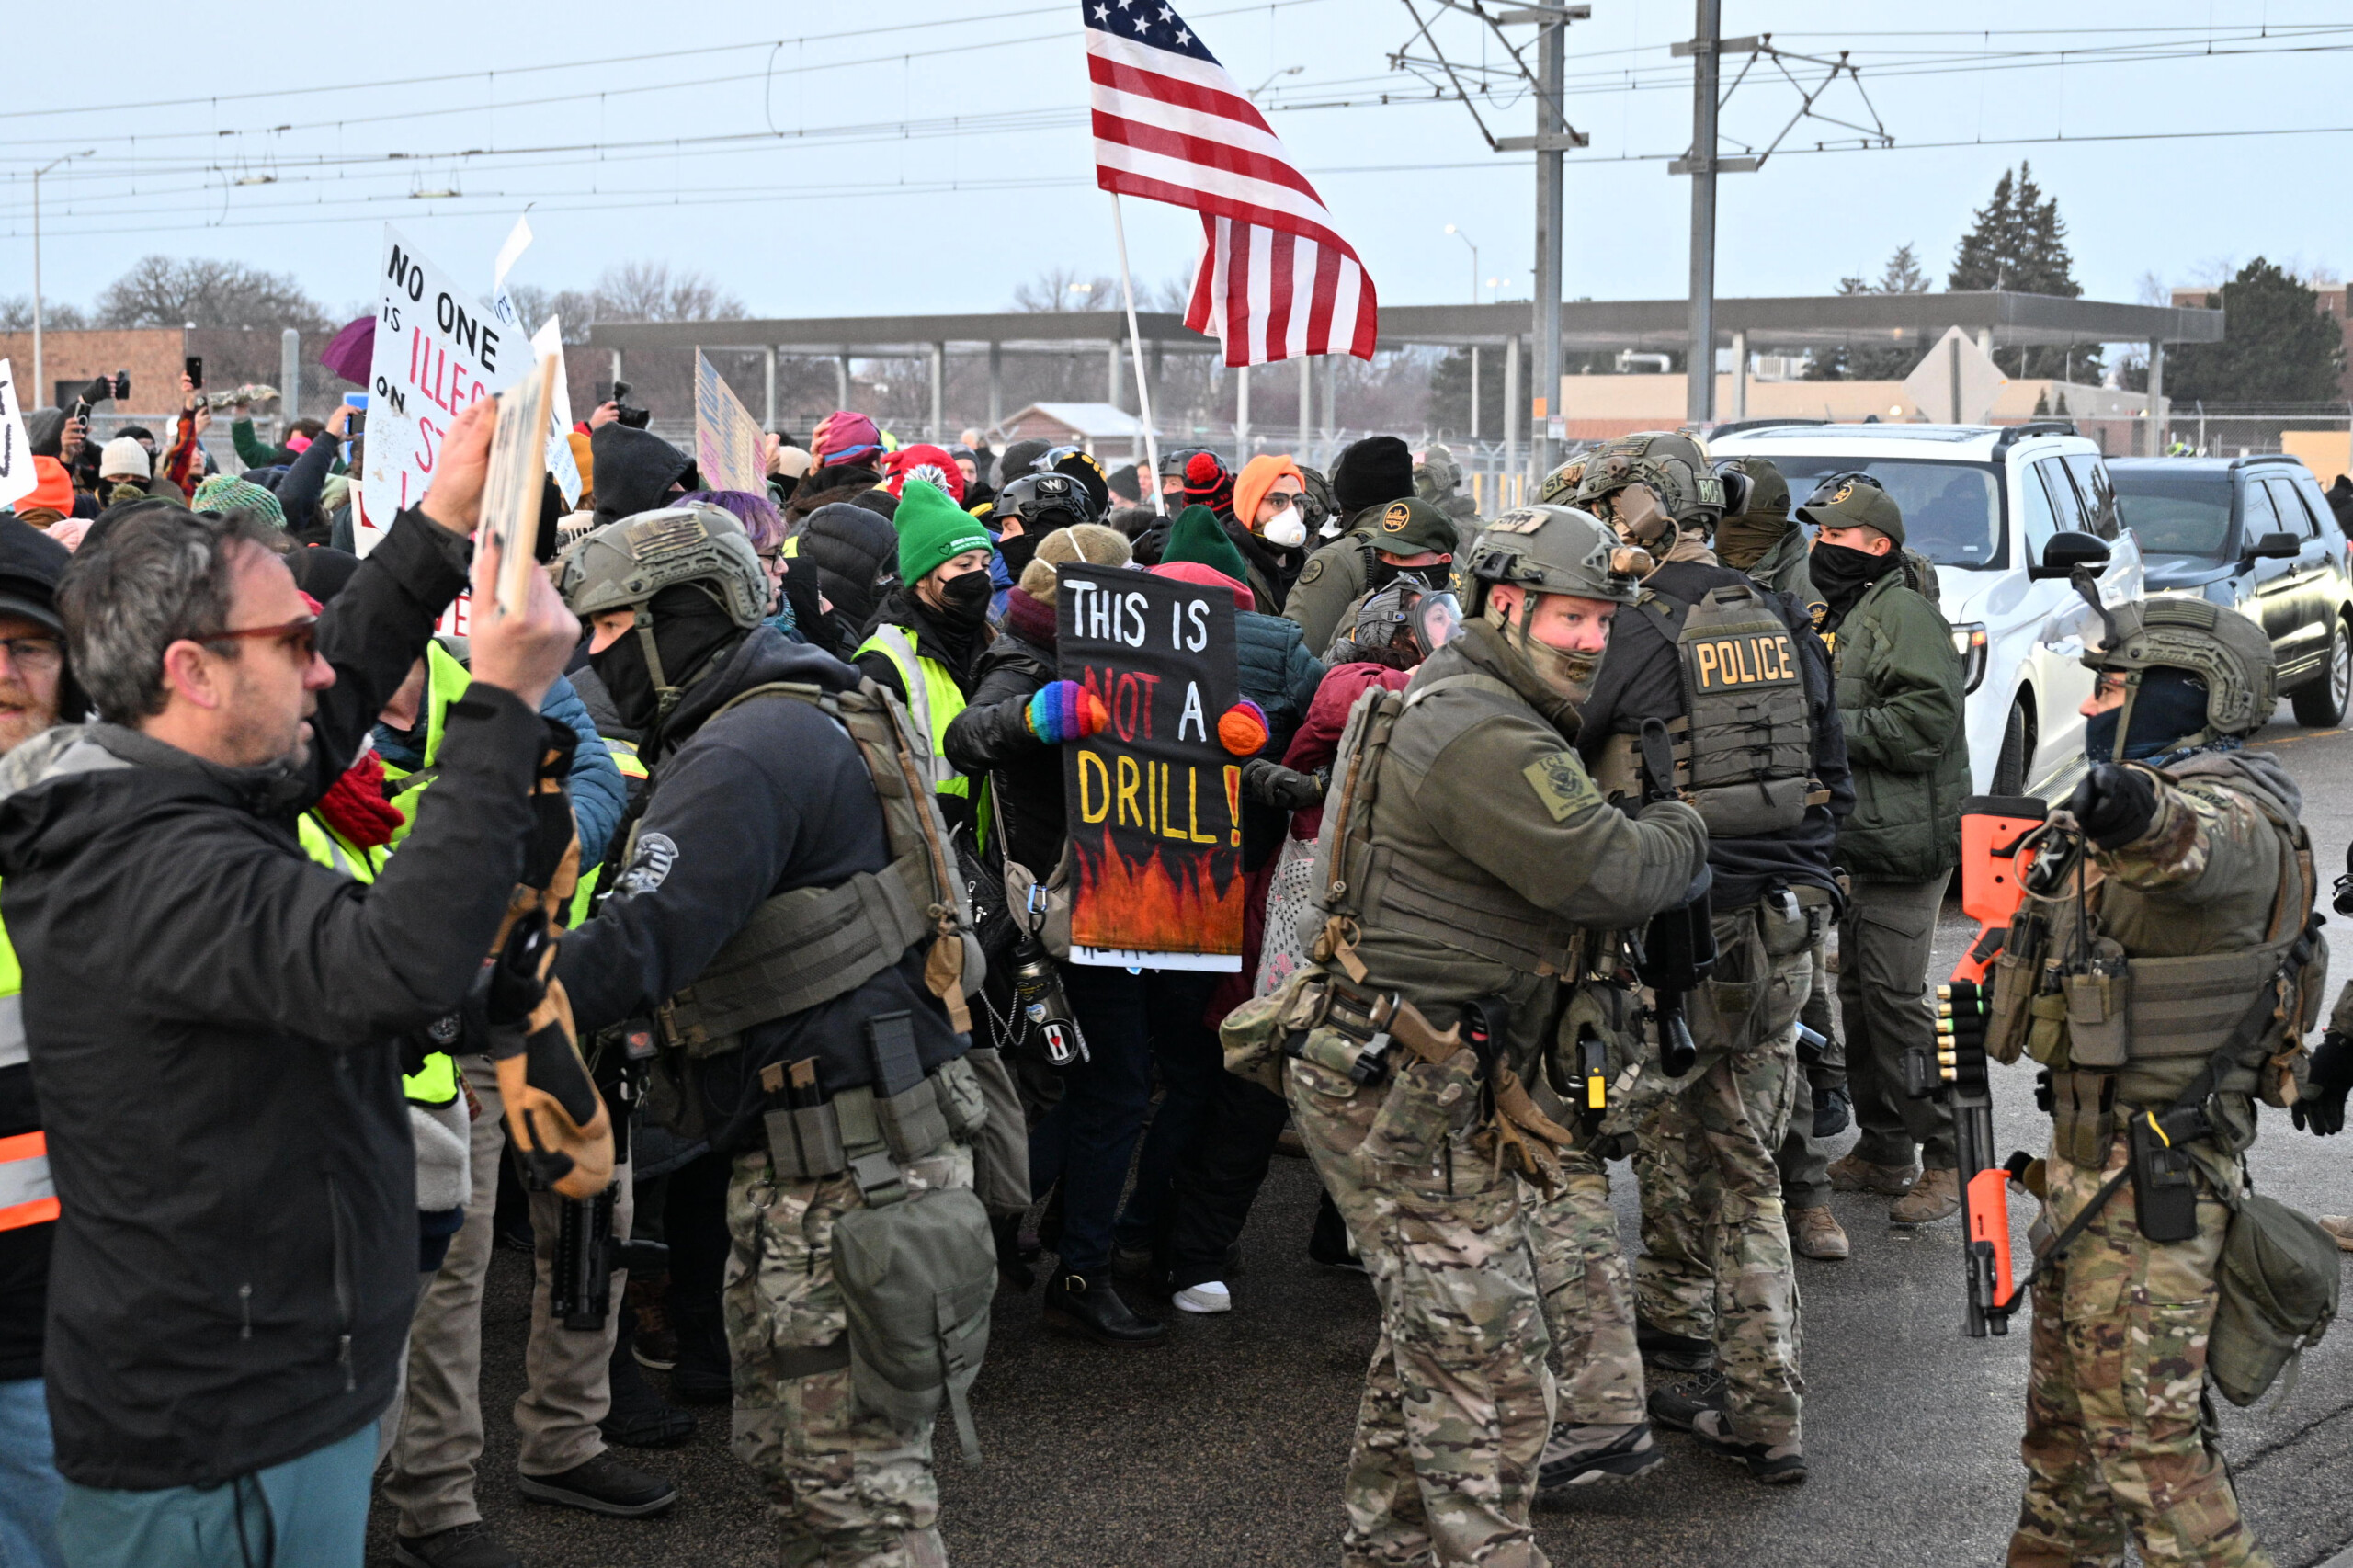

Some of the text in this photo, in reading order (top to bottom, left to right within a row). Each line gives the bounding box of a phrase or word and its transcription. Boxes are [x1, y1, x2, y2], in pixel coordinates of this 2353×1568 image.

[388, 244, 500, 374] NO ONE
[376, 376, 405, 413] ON
[1063, 579, 1210, 653] THIS IS
[1696, 636, 1795, 687] POLICE
[1084, 665, 1207, 743] NOT A
[1539, 754, 1565, 772] ICE
